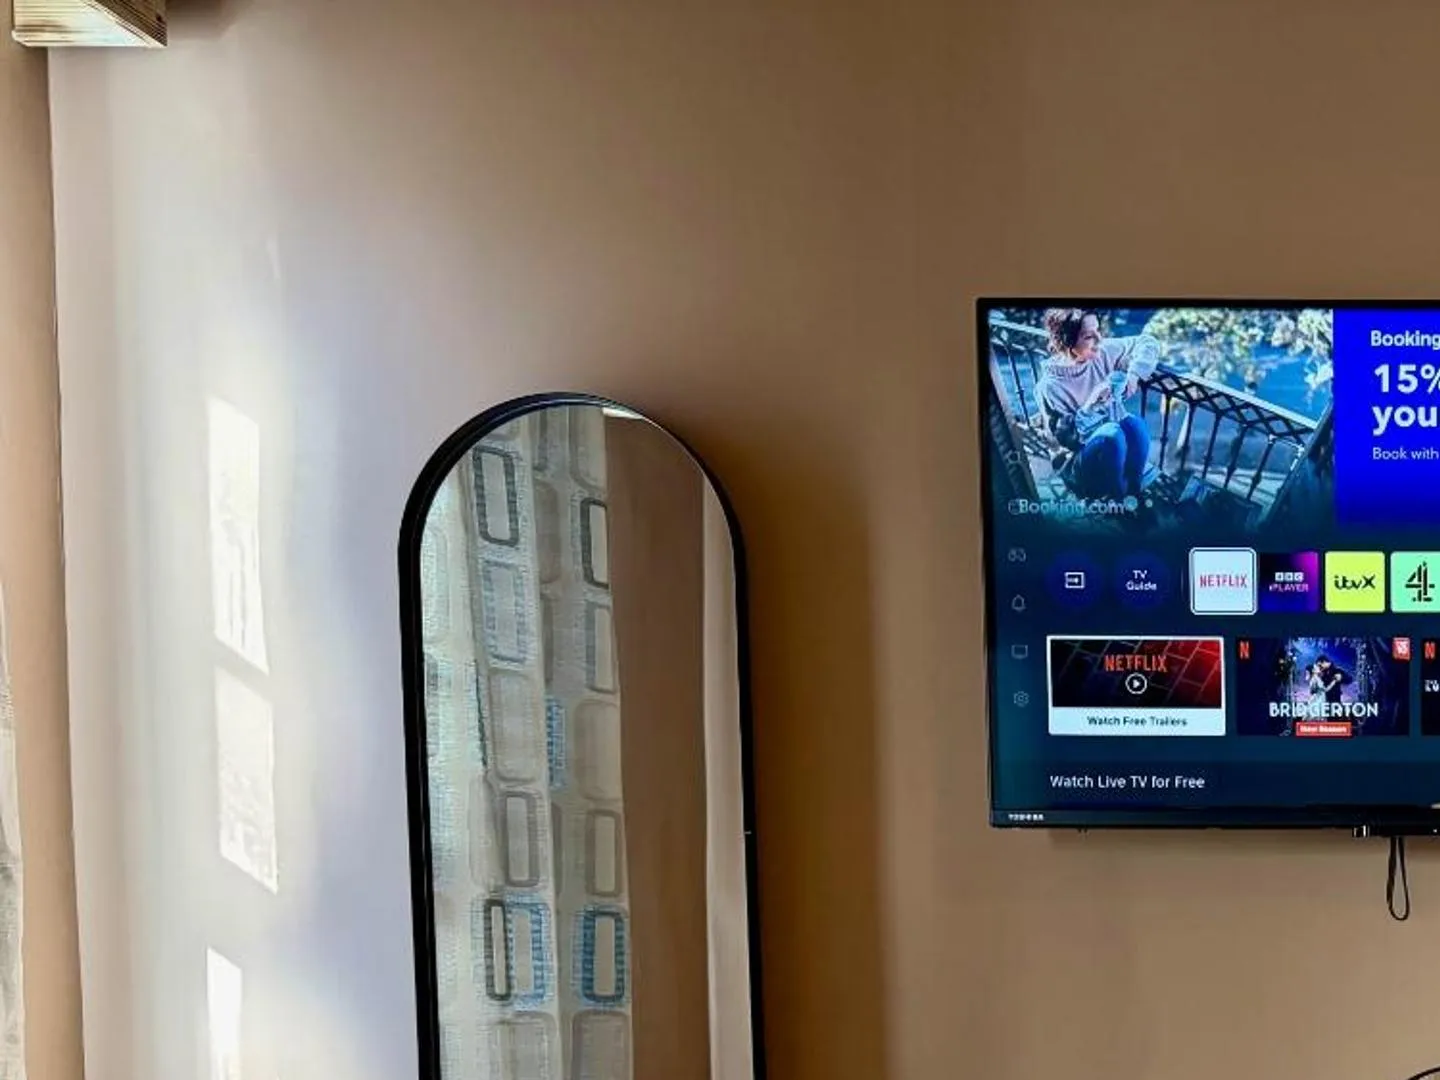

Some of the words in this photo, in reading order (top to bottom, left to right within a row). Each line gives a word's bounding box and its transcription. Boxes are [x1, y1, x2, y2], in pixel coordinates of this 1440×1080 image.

[1372, 446, 1407, 460] Book
[1411, 446, 1439, 460] with
[1132, 569, 1148, 580] TV
[1199, 574, 1248, 588] NETFLIX
[1125, 580, 1158, 591] Guide
[1104, 654, 1169, 673] NETFLIX
[1268, 702, 1379, 717] BRIDGERTON
[1087, 716, 1121, 727] Watch
[1122, 716, 1147, 727] Free
[1150, 716, 1188, 727] Trailers
[1050, 775, 1093, 788] Watch
[1097, 775, 1126, 788] Live
[1130, 775, 1148, 788] TV
[1151, 775, 1170, 788] for
[1174, 775, 1205, 788] Free
